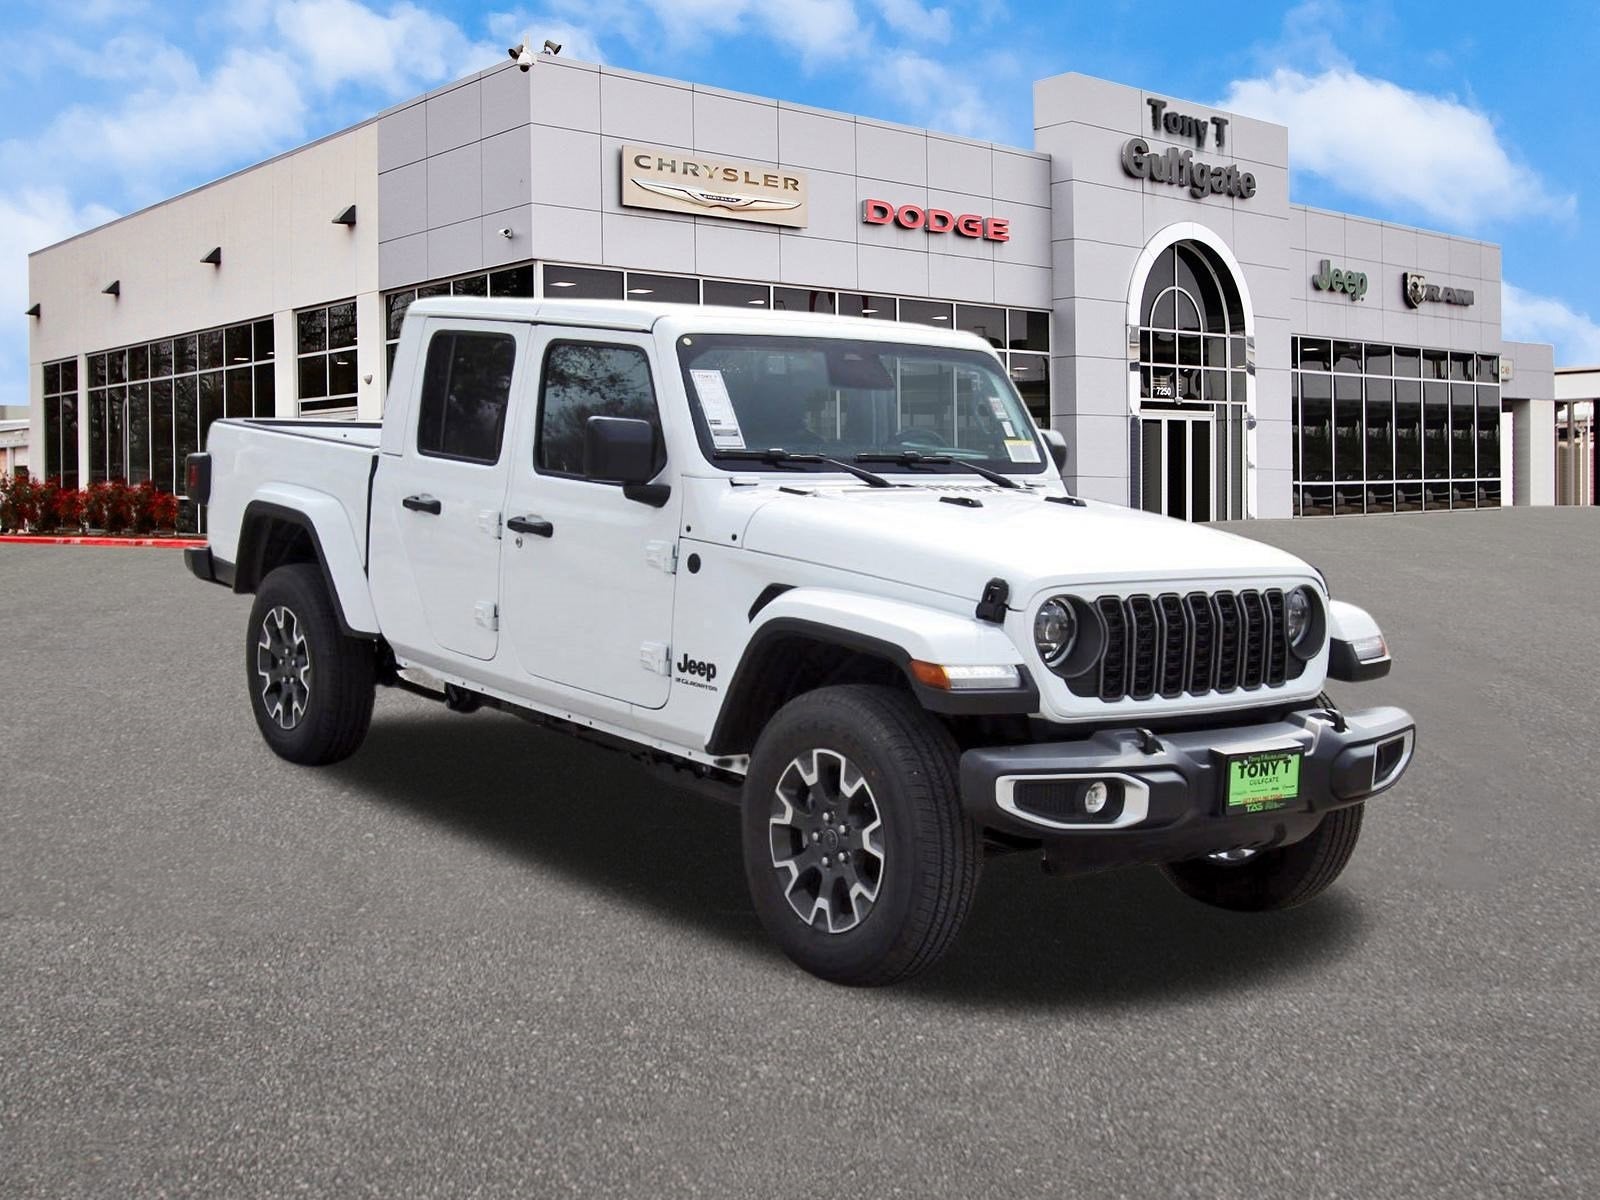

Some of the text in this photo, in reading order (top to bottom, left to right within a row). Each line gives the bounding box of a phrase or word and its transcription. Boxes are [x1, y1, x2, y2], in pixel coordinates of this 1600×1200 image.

[1146, 98, 1229, 148] Tony T
[633, 154, 800, 192] CHRYSLER
[1121, 137, 1256, 199] Gulfgate
[862, 198, 1010, 242] DODGE
[1313, 259, 1368, 302] Jeep
[1425, 284, 1475, 307] RAM
[1156, 386, 1172, 396] 7250
[677, 653, 717, 682] Jeep
[1238, 759, 1292, 779] TONY T
